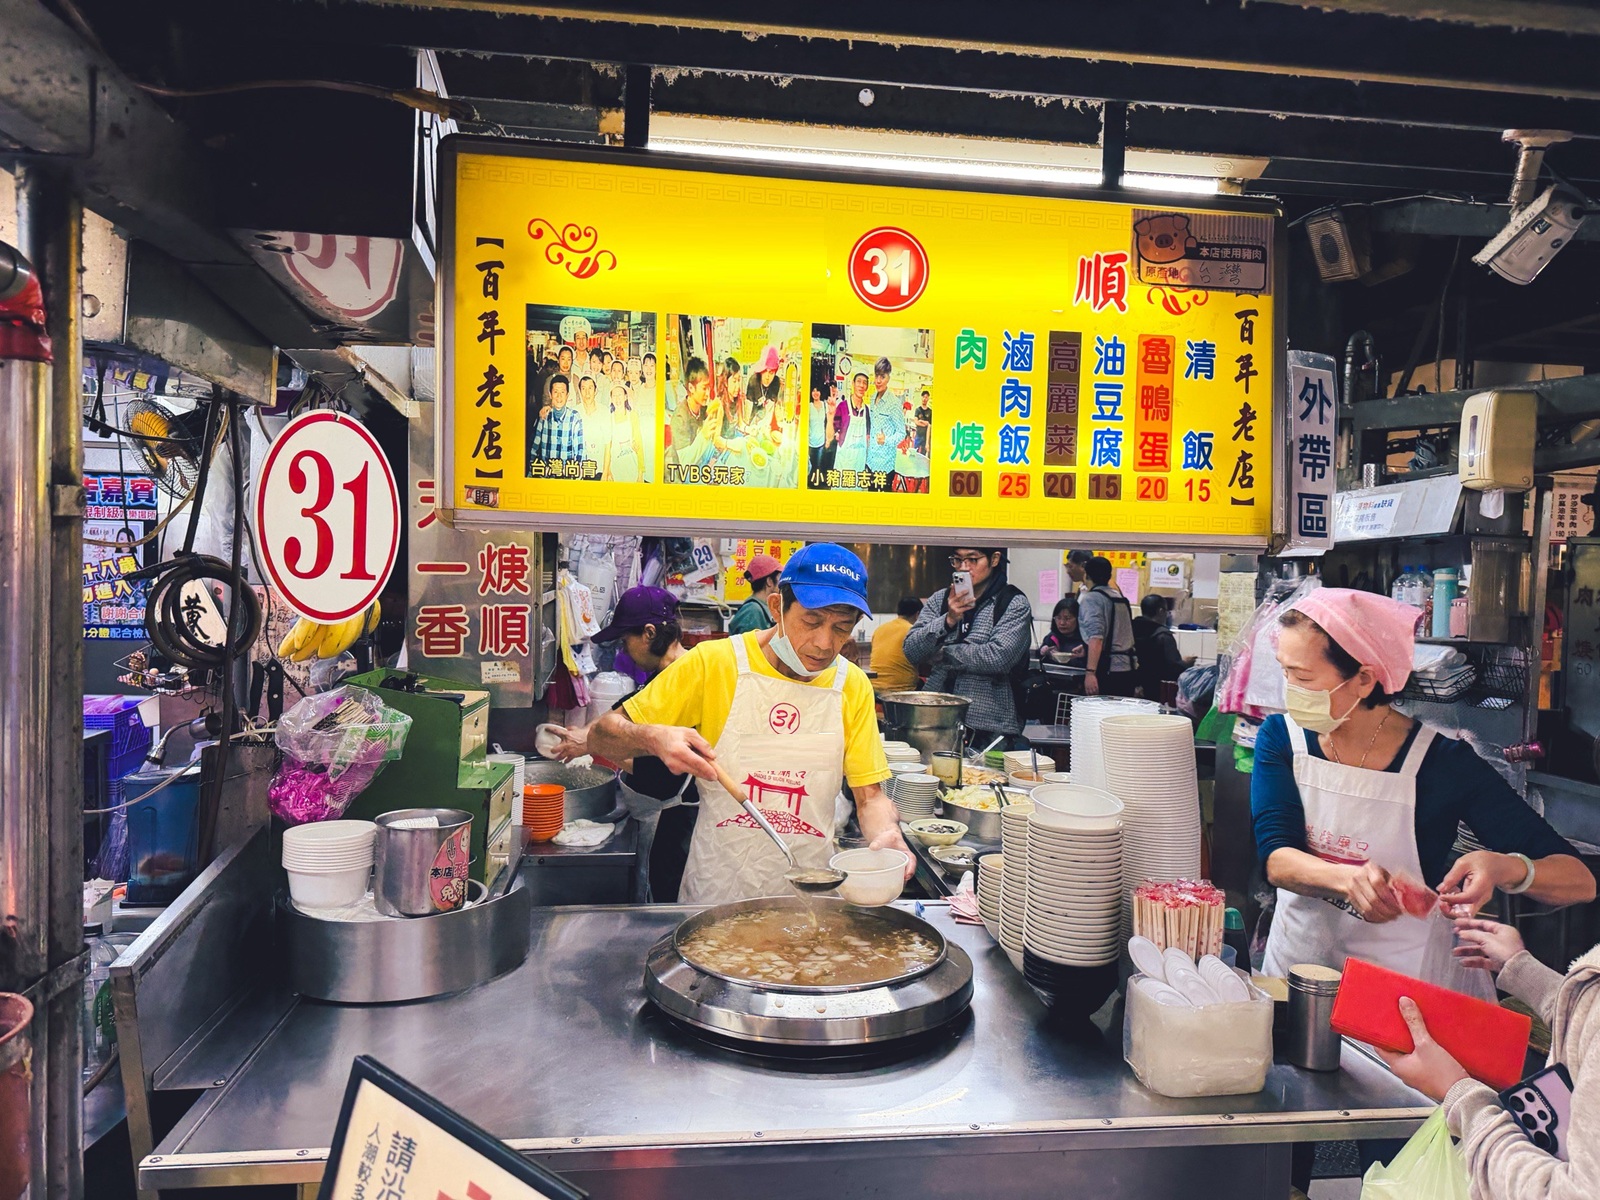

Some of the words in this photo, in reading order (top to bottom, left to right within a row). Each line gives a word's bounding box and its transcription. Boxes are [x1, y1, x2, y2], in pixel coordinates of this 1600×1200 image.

[1199, 247, 1262, 260] 本店使用豬肉
[861, 247, 914, 297] 31
[1074, 251, 1129, 313] 順
[1145, 265, 1179, 279] 原產地
[998, 330, 1034, 466] 滷肉飯
[1046, 338, 1081, 457] 高麗菜
[1090, 335, 1127, 468] 油豆腐
[1137, 337, 1173, 470] 魯鴨蛋
[530, 458, 598, 479] 台灣尚青
[1298, 376, 1333, 538] 外帶區
[666, 464, 745, 485] TVBS玩家
[810, 469, 887, 489] 小豬羅志祥
[951, 473, 980, 496] 60
[1000, 474, 1029, 497] 25
[1046, 474, 1075, 498] 20
[1093, 475, 1118, 498] 15
[1140, 478, 1166, 501] 20
[1185, 478, 1210, 502] 15
[283, 449, 377, 581] 31
[694, 545, 713, 565] 29
[815, 563, 861, 581] LKK-GOLF
[83, 627, 151, 639] 分證配合檢
[772, 709, 798, 729] 31
